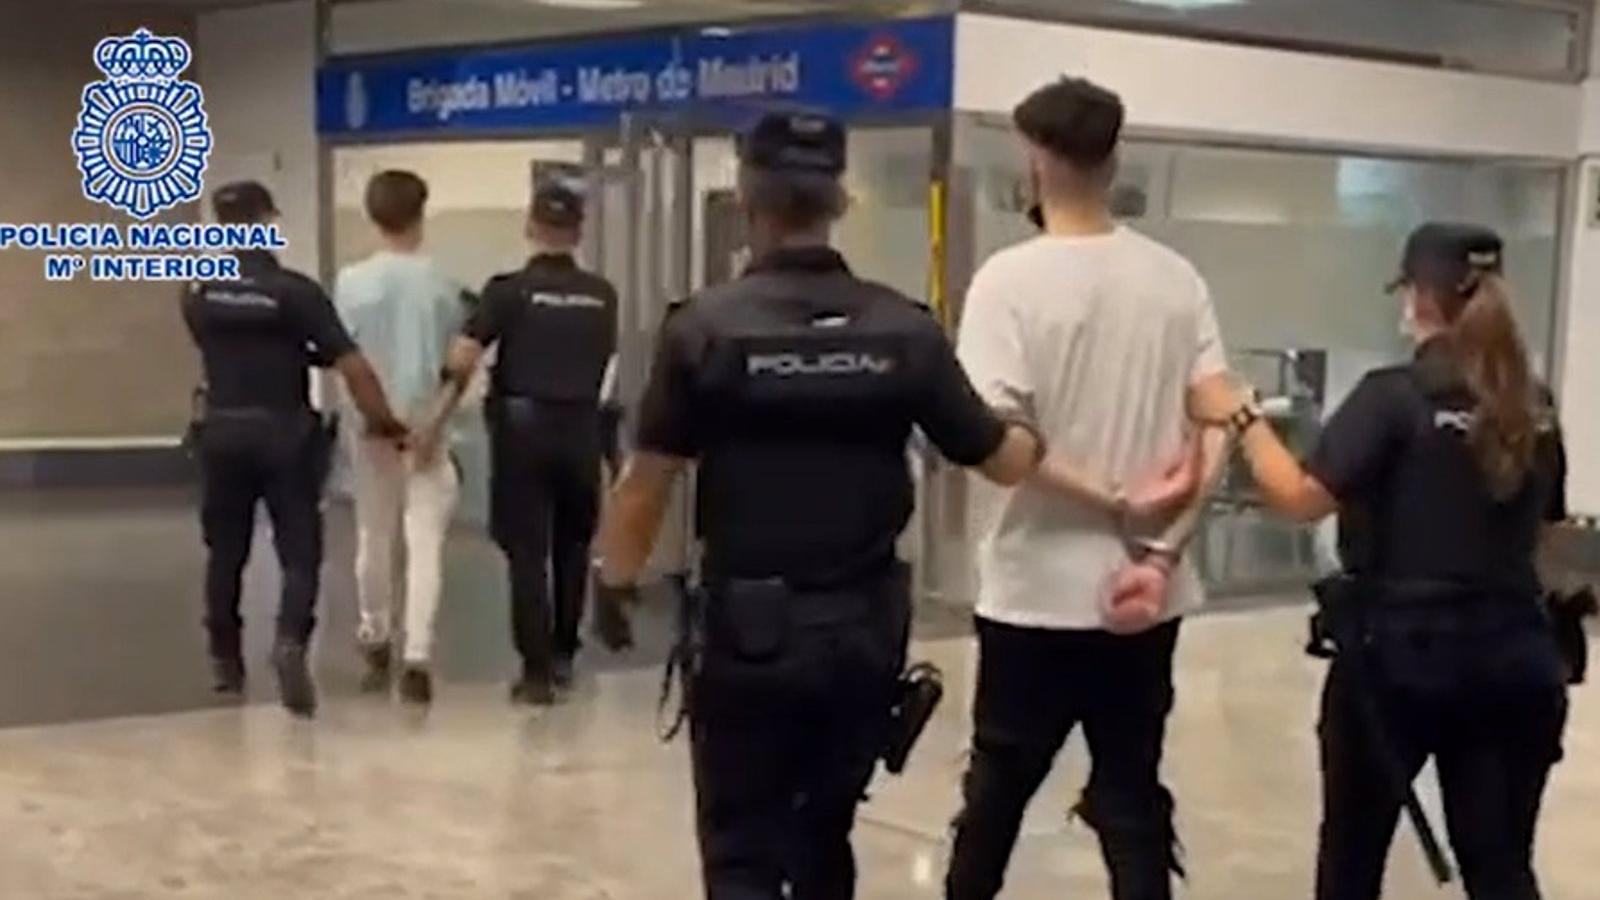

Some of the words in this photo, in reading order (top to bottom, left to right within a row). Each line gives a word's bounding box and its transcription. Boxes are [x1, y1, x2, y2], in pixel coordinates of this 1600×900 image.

[407, 73, 491, 121] Brigada
[493, 67, 558, 109] Móvil
[577, 64, 651, 105] Metro
[655, 60, 691, 100] de
[697, 52, 799, 99] Madrid
